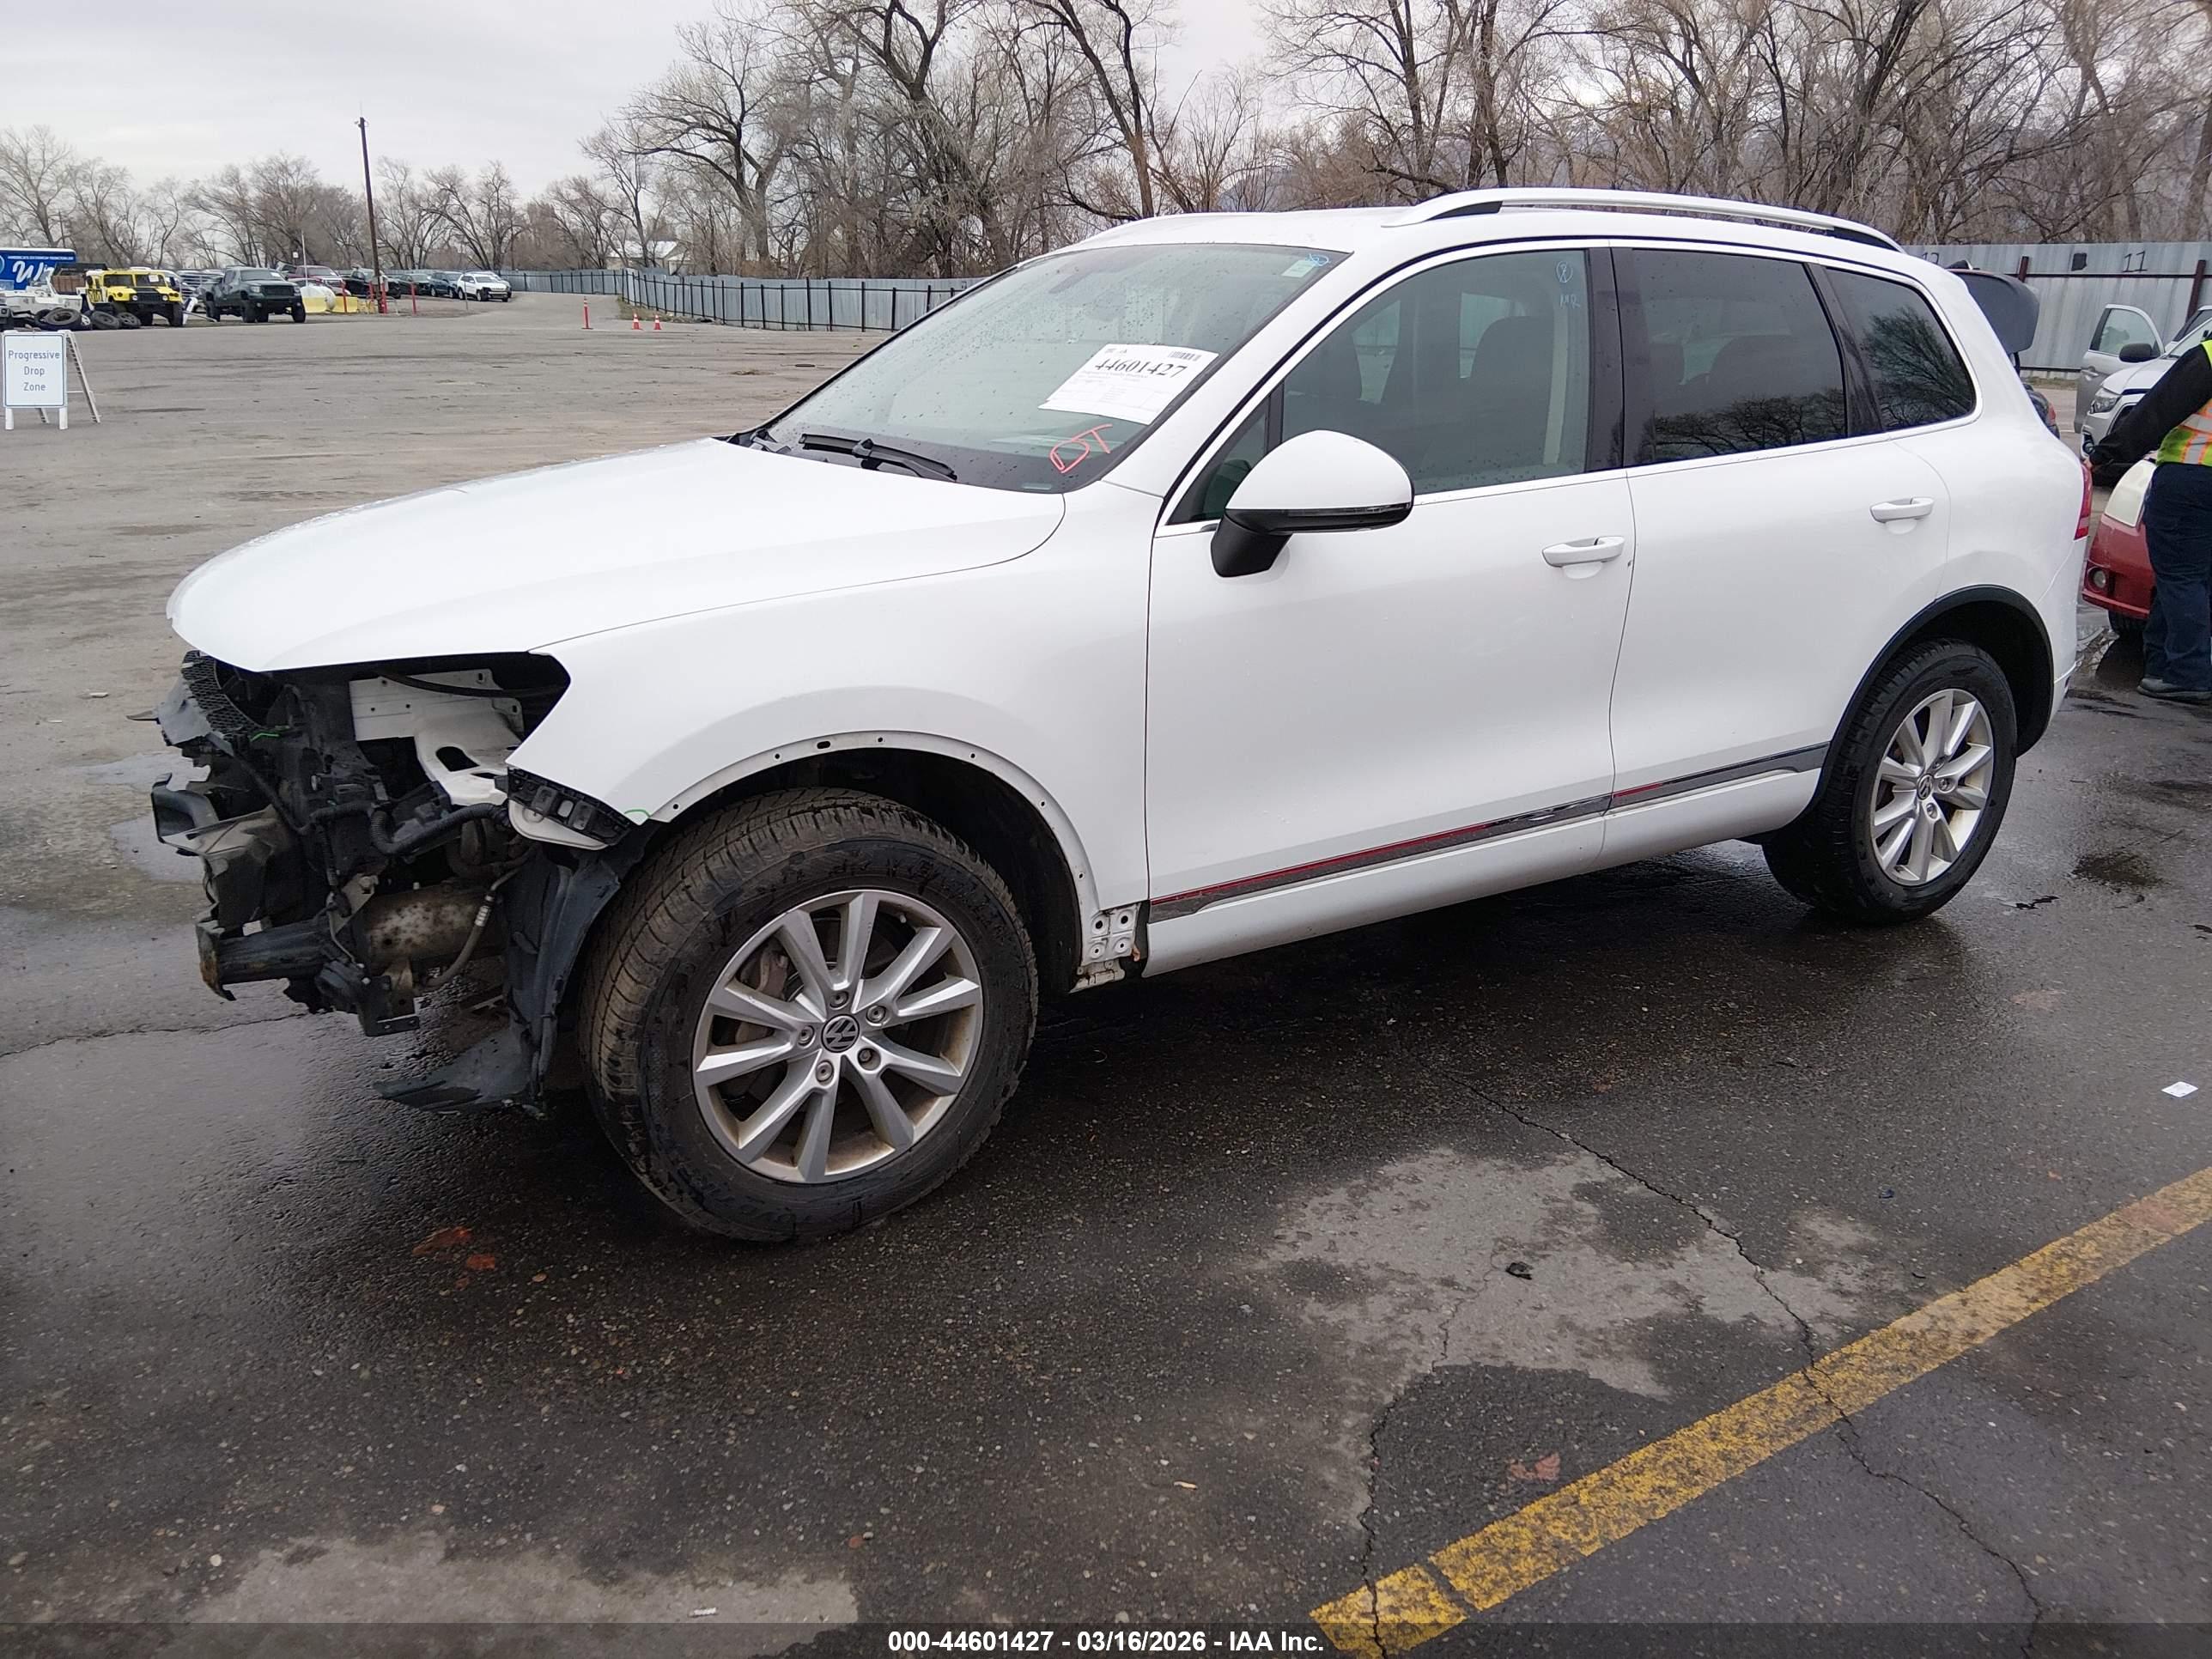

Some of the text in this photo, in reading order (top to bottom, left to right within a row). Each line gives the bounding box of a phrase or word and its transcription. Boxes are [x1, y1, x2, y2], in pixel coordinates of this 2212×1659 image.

[2123, 251, 2148, 272] 11
[8, 350, 60, 362] Progressive
[23, 367, 46, 377] Drop
[1095, 358, 1188, 378] 44601427
[23, 382, 46, 392] Zone
